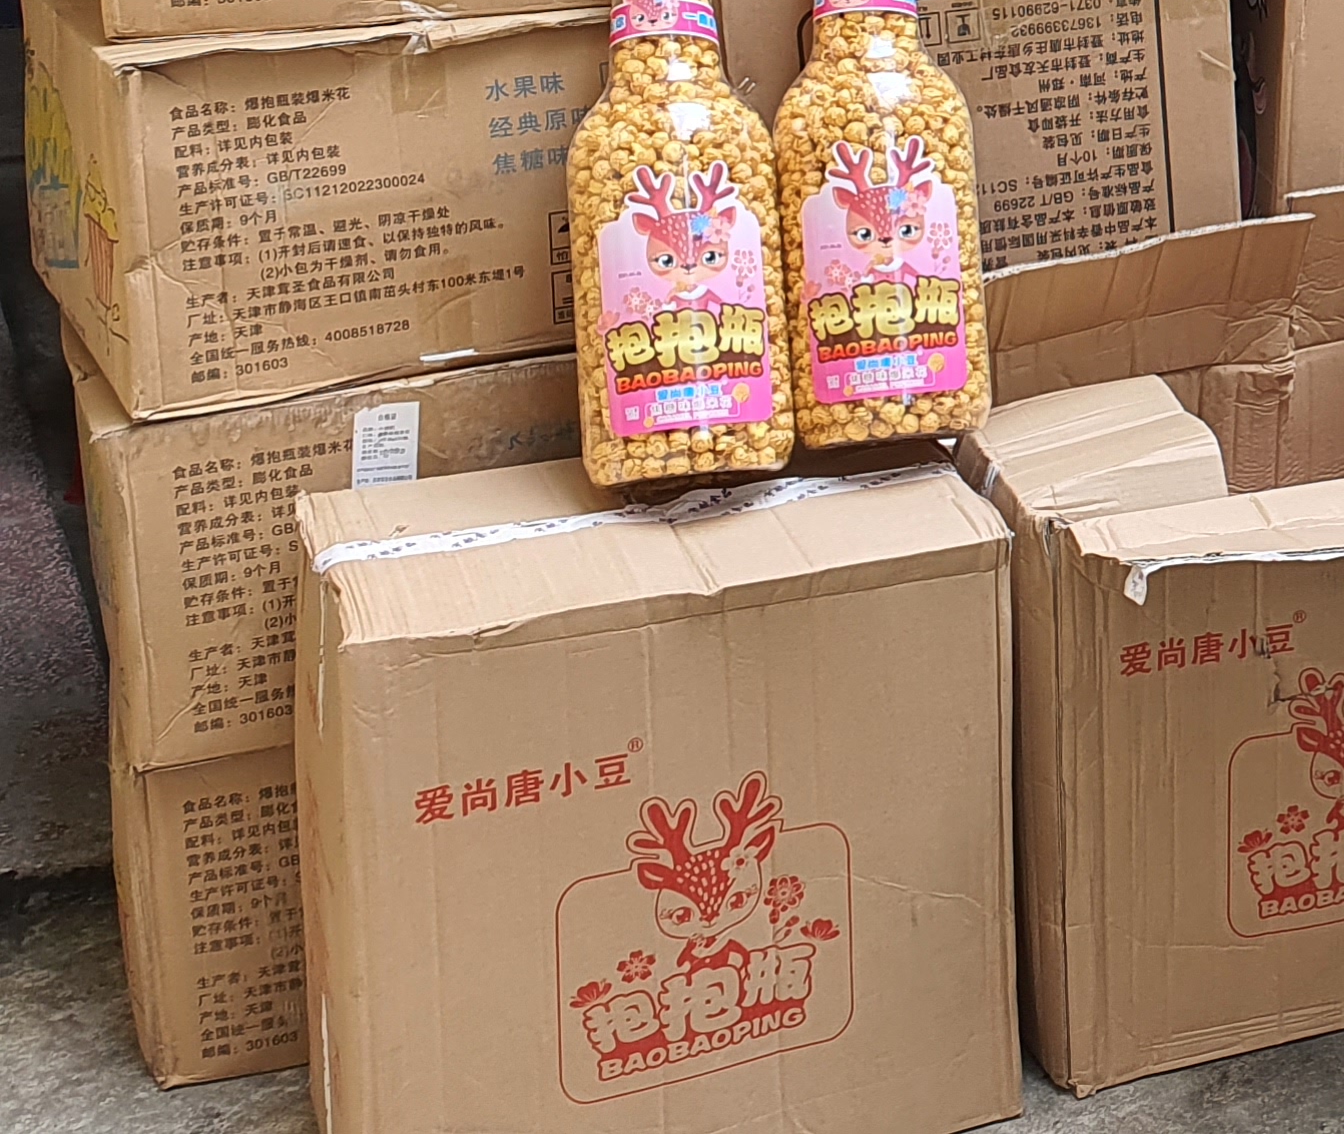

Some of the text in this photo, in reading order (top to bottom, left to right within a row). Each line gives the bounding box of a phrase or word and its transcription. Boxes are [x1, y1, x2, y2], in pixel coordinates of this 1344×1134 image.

[485, 72, 565, 103] 水果味
[606, 303, 765, 371] 抱抱瓶
[808, 276, 960, 340] 抱抱瓶
[616, 362, 763, 394] BAOBAOPING
[818, 332, 958, 363] BAOBAOPING
[583, 943, 816, 1054] 抱抱瓶
[598, 1008, 807, 1081] BAOBAOPING
